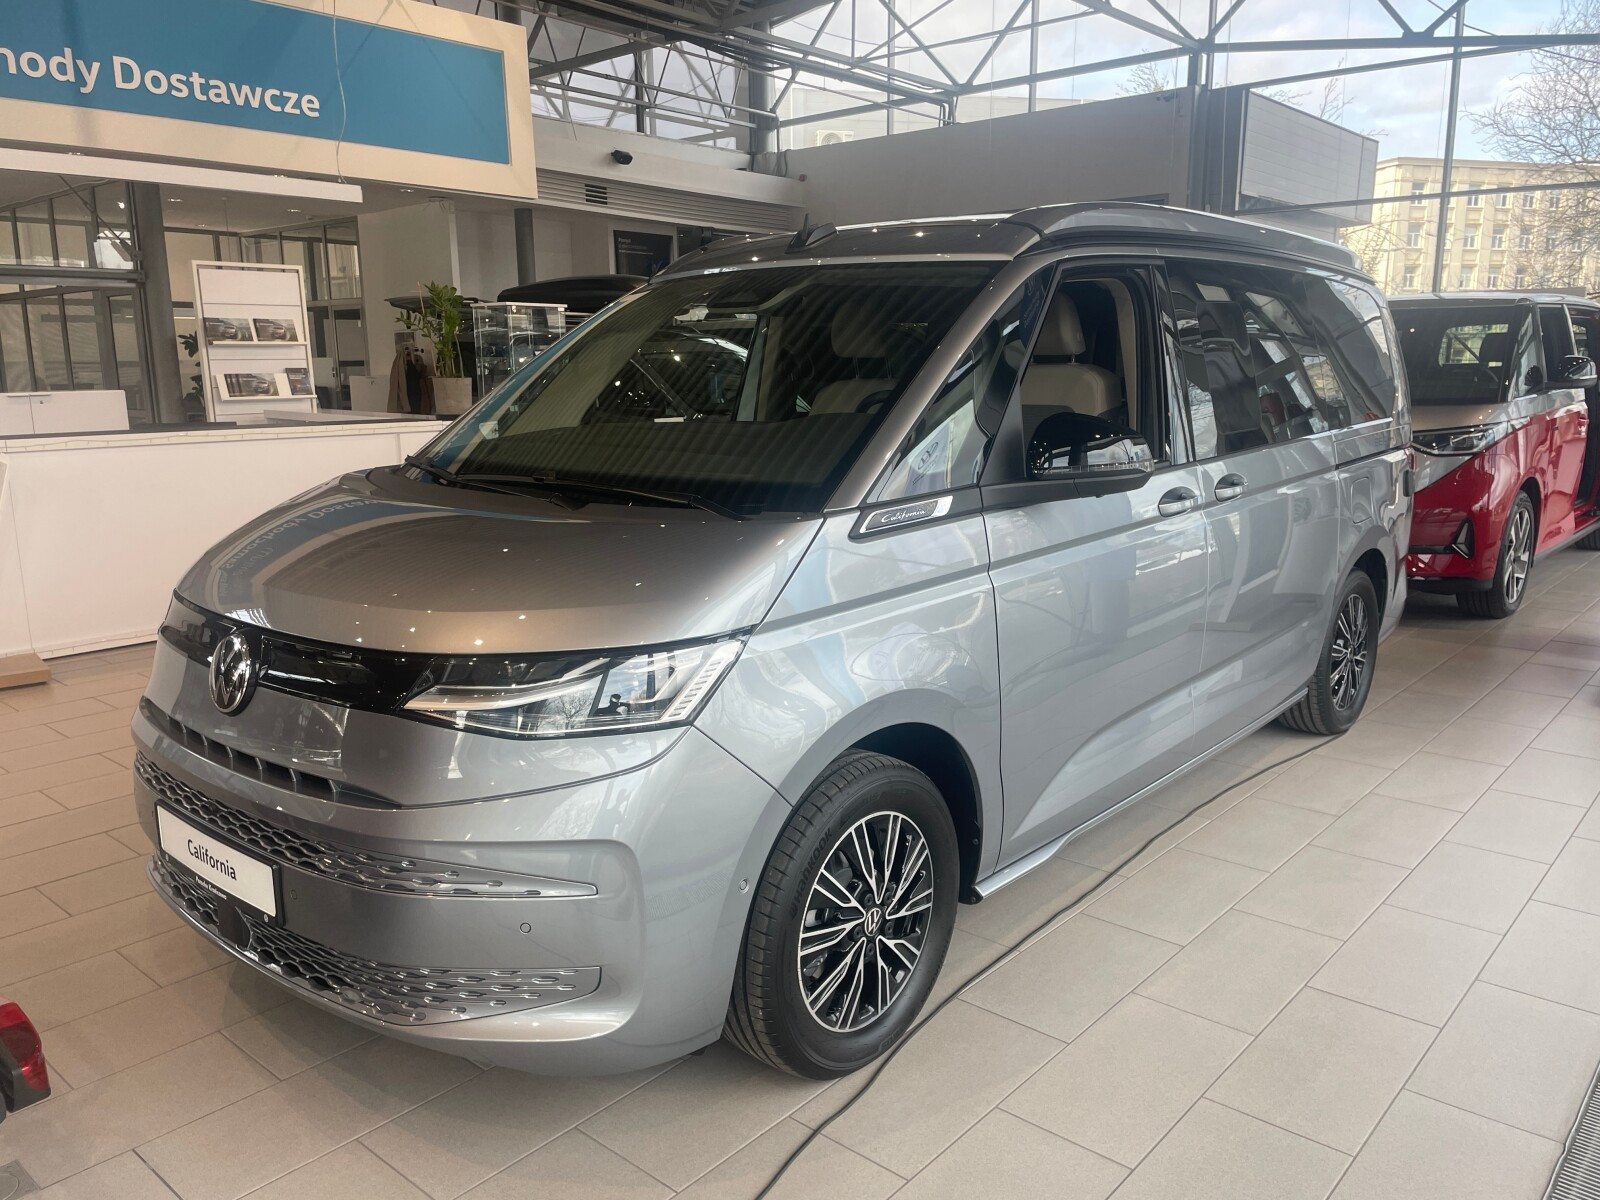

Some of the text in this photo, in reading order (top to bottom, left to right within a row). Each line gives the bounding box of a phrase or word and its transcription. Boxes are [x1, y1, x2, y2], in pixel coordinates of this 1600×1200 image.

[111, 55, 321, 118] Dostawcze
[881, 509, 926, 523] California
[187, 838, 238, 881] California
